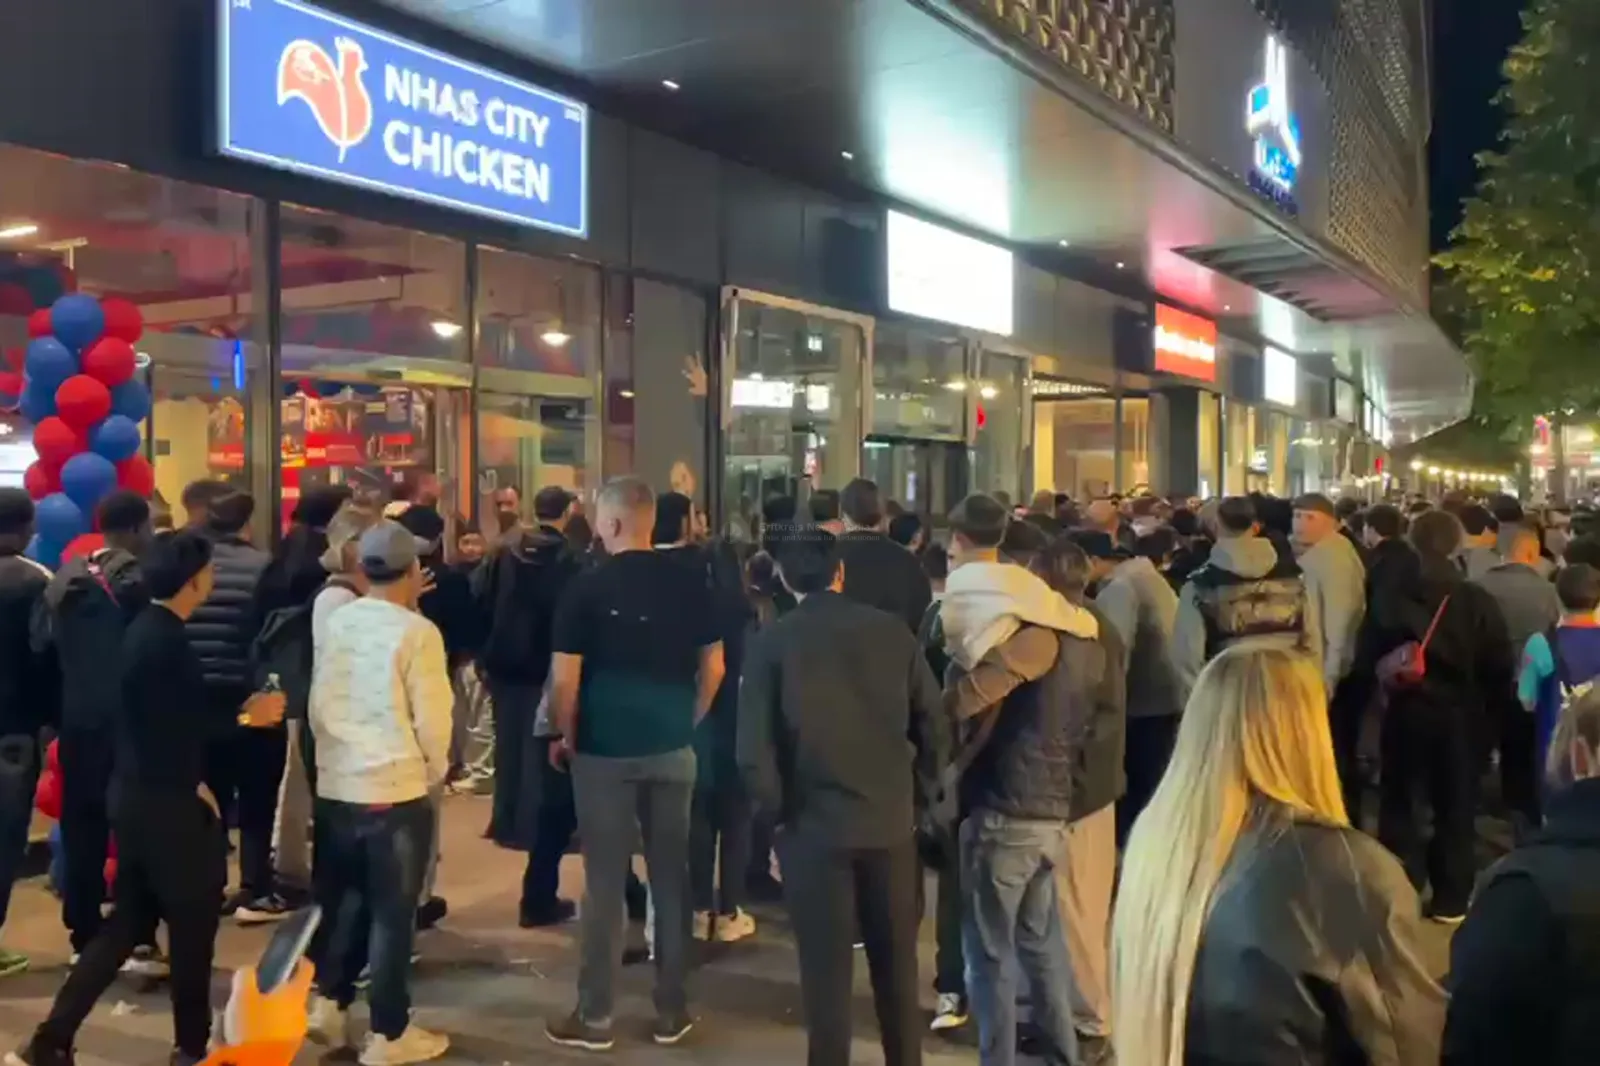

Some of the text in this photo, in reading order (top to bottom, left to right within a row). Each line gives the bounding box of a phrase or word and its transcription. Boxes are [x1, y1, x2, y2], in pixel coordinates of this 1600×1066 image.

[384, 63, 550, 149] NHAS CITY
[382, 119, 550, 204] CHICKEN
